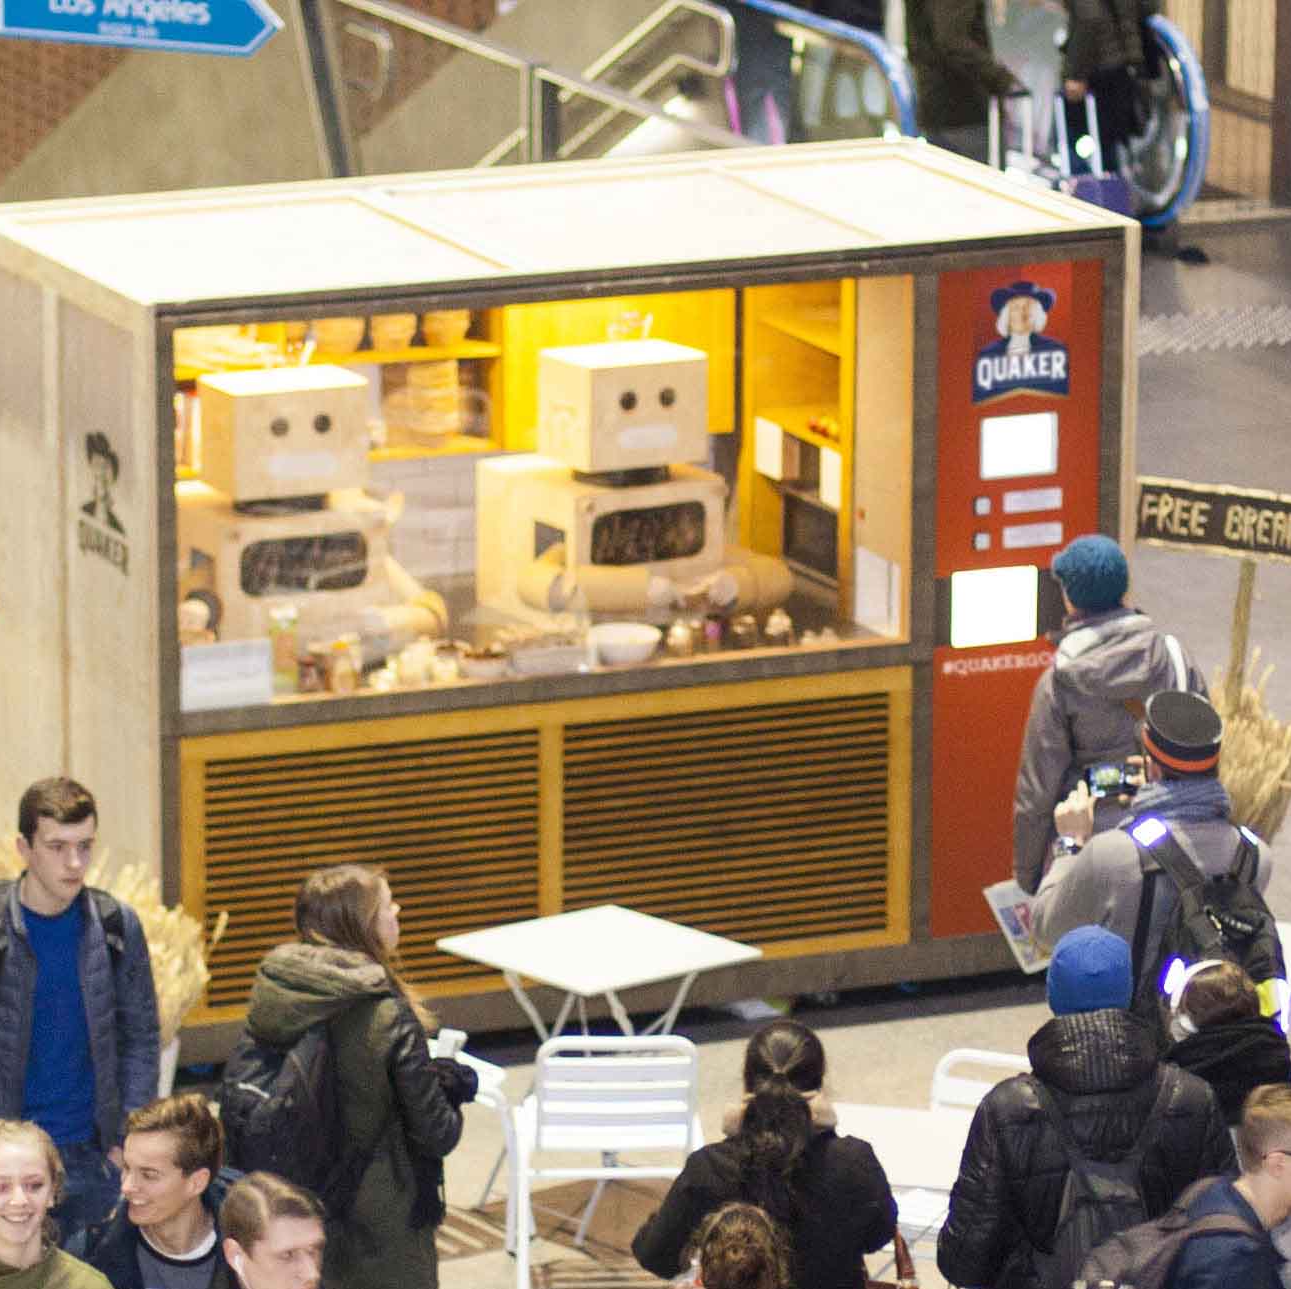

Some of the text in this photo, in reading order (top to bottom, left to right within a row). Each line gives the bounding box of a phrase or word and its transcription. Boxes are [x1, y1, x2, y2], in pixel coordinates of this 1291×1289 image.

[102, 0, 212, 25] Angeles
[976, 351, 1067, 391] QUAKER
[1140, 493, 1212, 537] FREE
